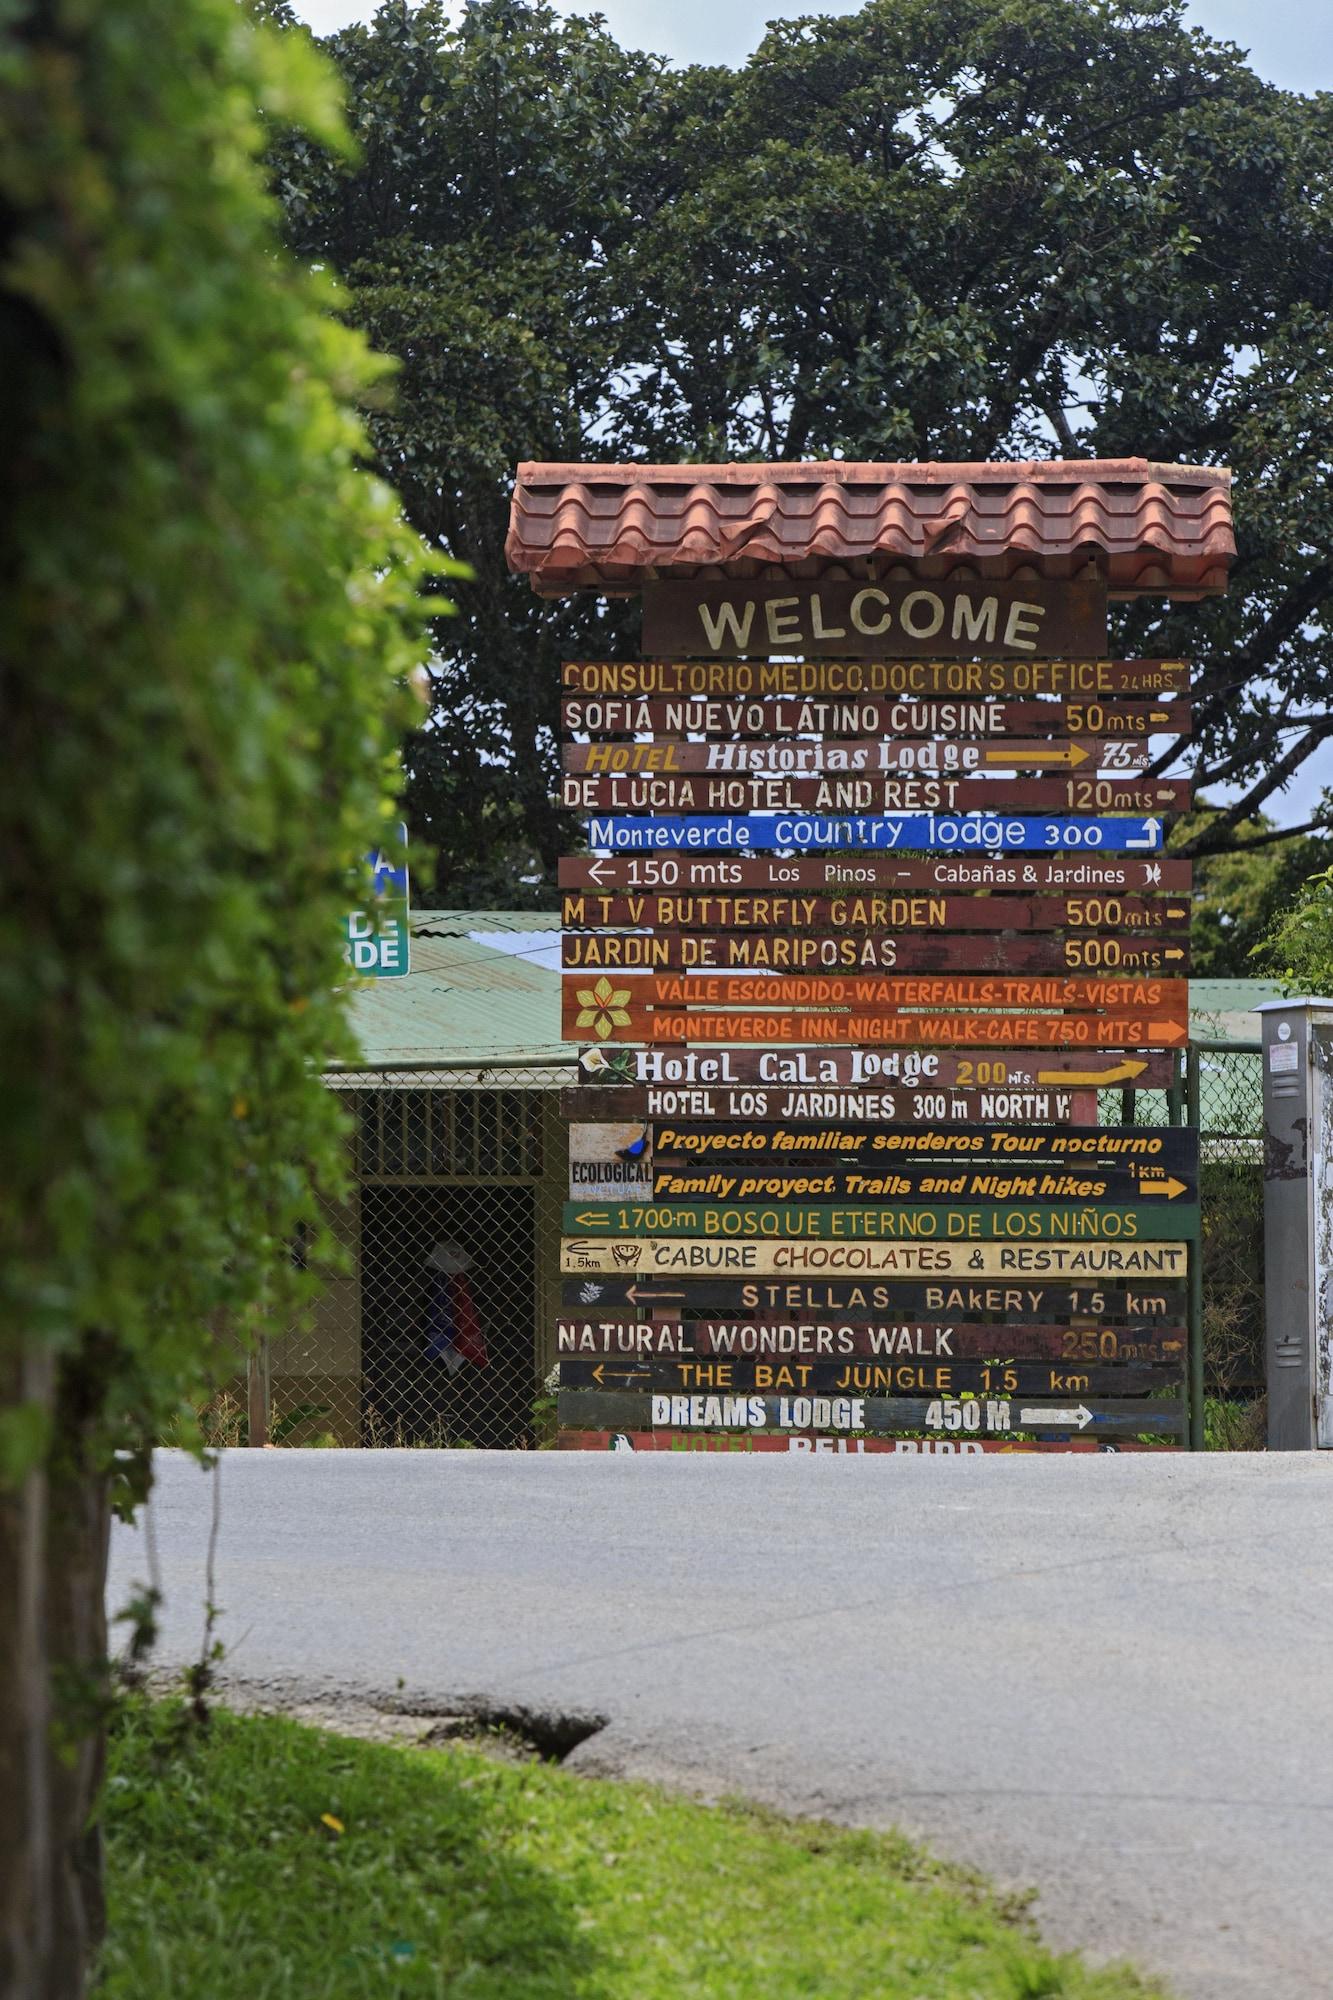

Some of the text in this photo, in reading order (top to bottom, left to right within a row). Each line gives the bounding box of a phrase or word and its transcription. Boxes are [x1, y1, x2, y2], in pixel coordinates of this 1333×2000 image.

[698, 588, 1045, 650] WELCOME
[563, 664, 753, 693] CONSULTORIO
[871, 663, 1005, 692] DOCTOR'S
[1013, 663, 1113, 691] OFFICE
[565, 702, 653, 730] SOFIA
[665, 702, 764, 731] NUEVO
[775, 704, 880, 731] LATINO
[891, 704, 1006, 731] CUISINE
[705, 743, 868, 771] Historias
[877, 741, 979, 770] Lodge
[563, 779, 599, 807] DE
[611, 780, 695, 808] LUCIA
[708, 780, 801, 808] HOTEL
[815, 781, 872, 808] AND
[884, 780, 959, 808] REST
[590, 819, 1103, 848] Monteverde country lodge 300
[626, 860, 679, 885] 150
[690, 861, 742, 884] mts
[769, 865, 800, 882] Los
[825, 865, 876, 882] Pinos
[934, 865, 1016, 882] Cabañas
[1022, 865, 1038, 882] &
[1045, 865, 1125, 884] Jardines
[564, 897, 585, 923] M
[598, 897, 613, 924] T
[628, 898, 645, 924] V
[658, 897, 817, 925] BUTTERFLY
[830, 898, 946, 926] GARDEN
[564, 938, 669, 965] JARDIN
[681, 938, 717, 966] DE
[729, 939, 897, 967] MARIPOSAS
[655, 980, 719, 1000] VALLE
[653, 1017, 792, 1039] MONTEVERDE
[1046, 1020, 1089, 1041] 750
[1098, 1022, 1141, 1041] MTS
[850, 1051, 939, 1086] Lodge
[648, 1090, 715, 1115] HOTEL
[730, 1092, 767, 1116] LOS
[782, 1092, 895, 1119] JARDINES
[913, 1094, 946, 1119] 300
[981, 1095, 1048, 1119] NORTH
[657, 1130, 1162, 1153] Proyecto familiar senderos Tour nocturno
[572, 1161, 653, 1183] ECOLOGICAL
[655, 1175, 735, 1197] Family
[845, 1175, 911, 1195] Trails
[919, 1177, 967, 1194] and
[970, 1176, 1036, 1198] Night
[1039, 1175, 1106, 1196] hikes
[704, 1210, 820, 1235] BOSQUE
[832, 1211, 936, 1236] ETERNO
[948, 1213, 981, 1236] DE
[992, 1213, 1041, 1236] LOS
[1051, 1208, 1137, 1236] NIÑOS
[773, 1247, 951, 1269] CHOCOLATES
[967, 1249, 984, 1269] &
[1000, 1249, 1182, 1270] RESTAURANT
[741, 1286, 889, 1308] STELLAS
[1069, 1292, 1105, 1313] 1.5
[1126, 1293, 1166, 1315] km
[558, 1324, 694, 1352] NATURAL
[708, 1325, 854, 1354] WONDERS
[868, 1327, 953, 1356] WALK
[677, 1364, 1089, 1391] THE BAT JUNGLE 1.5 km
[652, 1396, 1010, 1430] DREAMS LODGE 450 M
